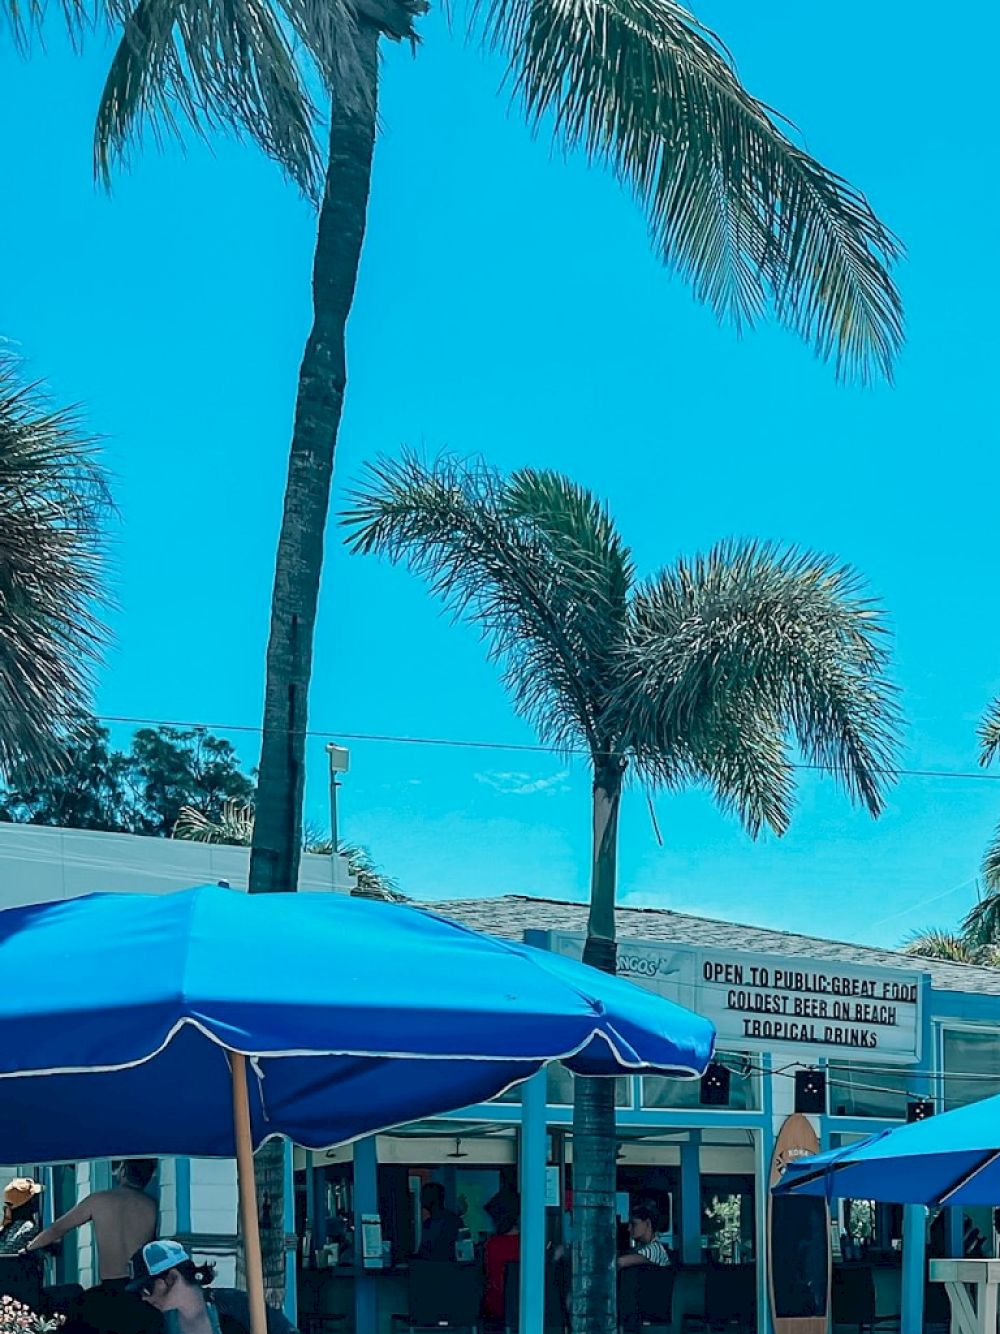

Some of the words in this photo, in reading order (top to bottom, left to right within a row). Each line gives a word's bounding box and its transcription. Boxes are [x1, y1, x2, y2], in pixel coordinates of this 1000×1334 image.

[616, 955, 657, 977] NGOS
[703, 961, 743, 985] OPEN
[750, 967, 769, 987] TO
[727, 990, 789, 1014] COLDEST
[794, 997, 828, 1018] BEER
[833, 1001, 850, 1020] ON
[855, 1003, 896, 1025] BEACH
[743, 1019, 815, 1043] TROPICAL
[824, 1025, 877, 1048] DRINKS
